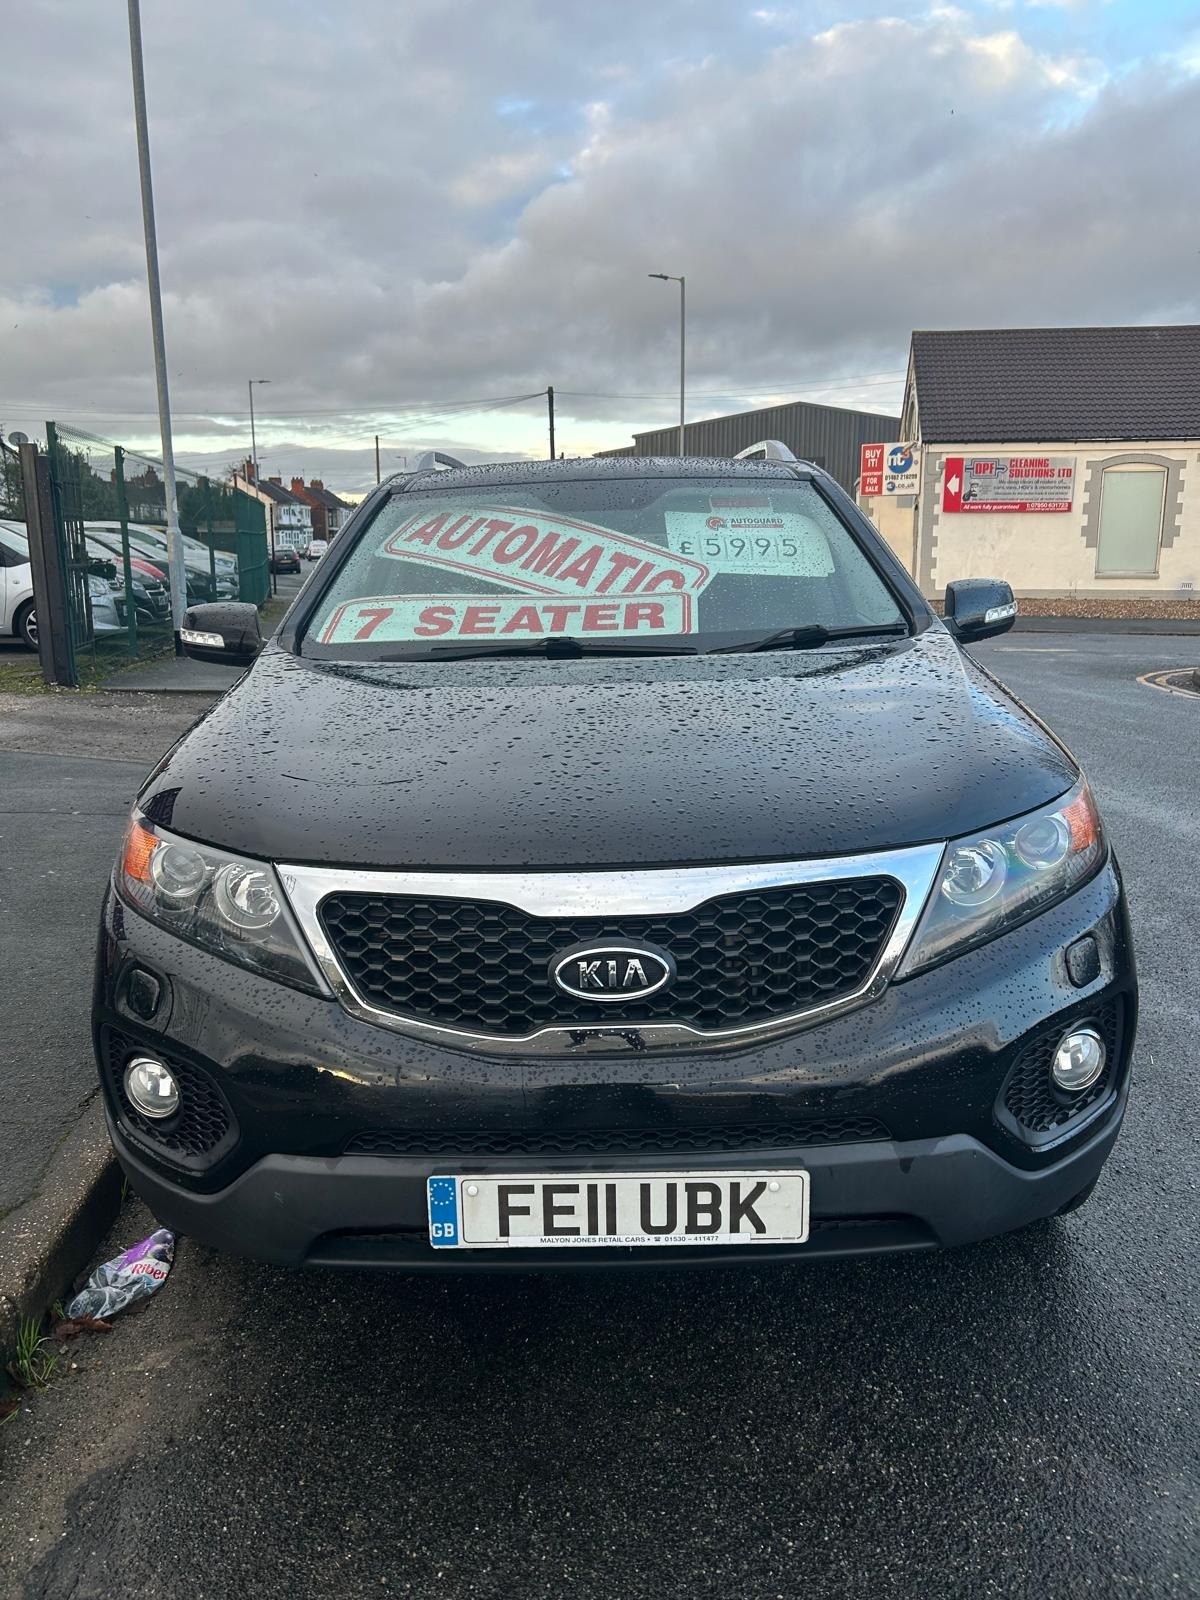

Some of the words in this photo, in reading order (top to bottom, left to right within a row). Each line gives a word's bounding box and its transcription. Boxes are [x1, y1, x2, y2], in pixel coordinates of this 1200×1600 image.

[865, 449, 881, 458] BUY
[868, 459, 878, 468] IT!
[1009, 458, 1049, 468] CLEANING
[1008, 468, 1055, 478] SOLUTIONS
[1057, 468, 1073, 478] LTD
[867, 477, 878, 485] FOR
[354, 608, 394, 640] 7
[414, 602, 666, 636] SEATER
[577, 958, 649, 988] KIA
[497, 1183, 617, 1237] FE11
[639, 1182, 768, 1236] UBK
[431, 1222, 455, 1238] GB
